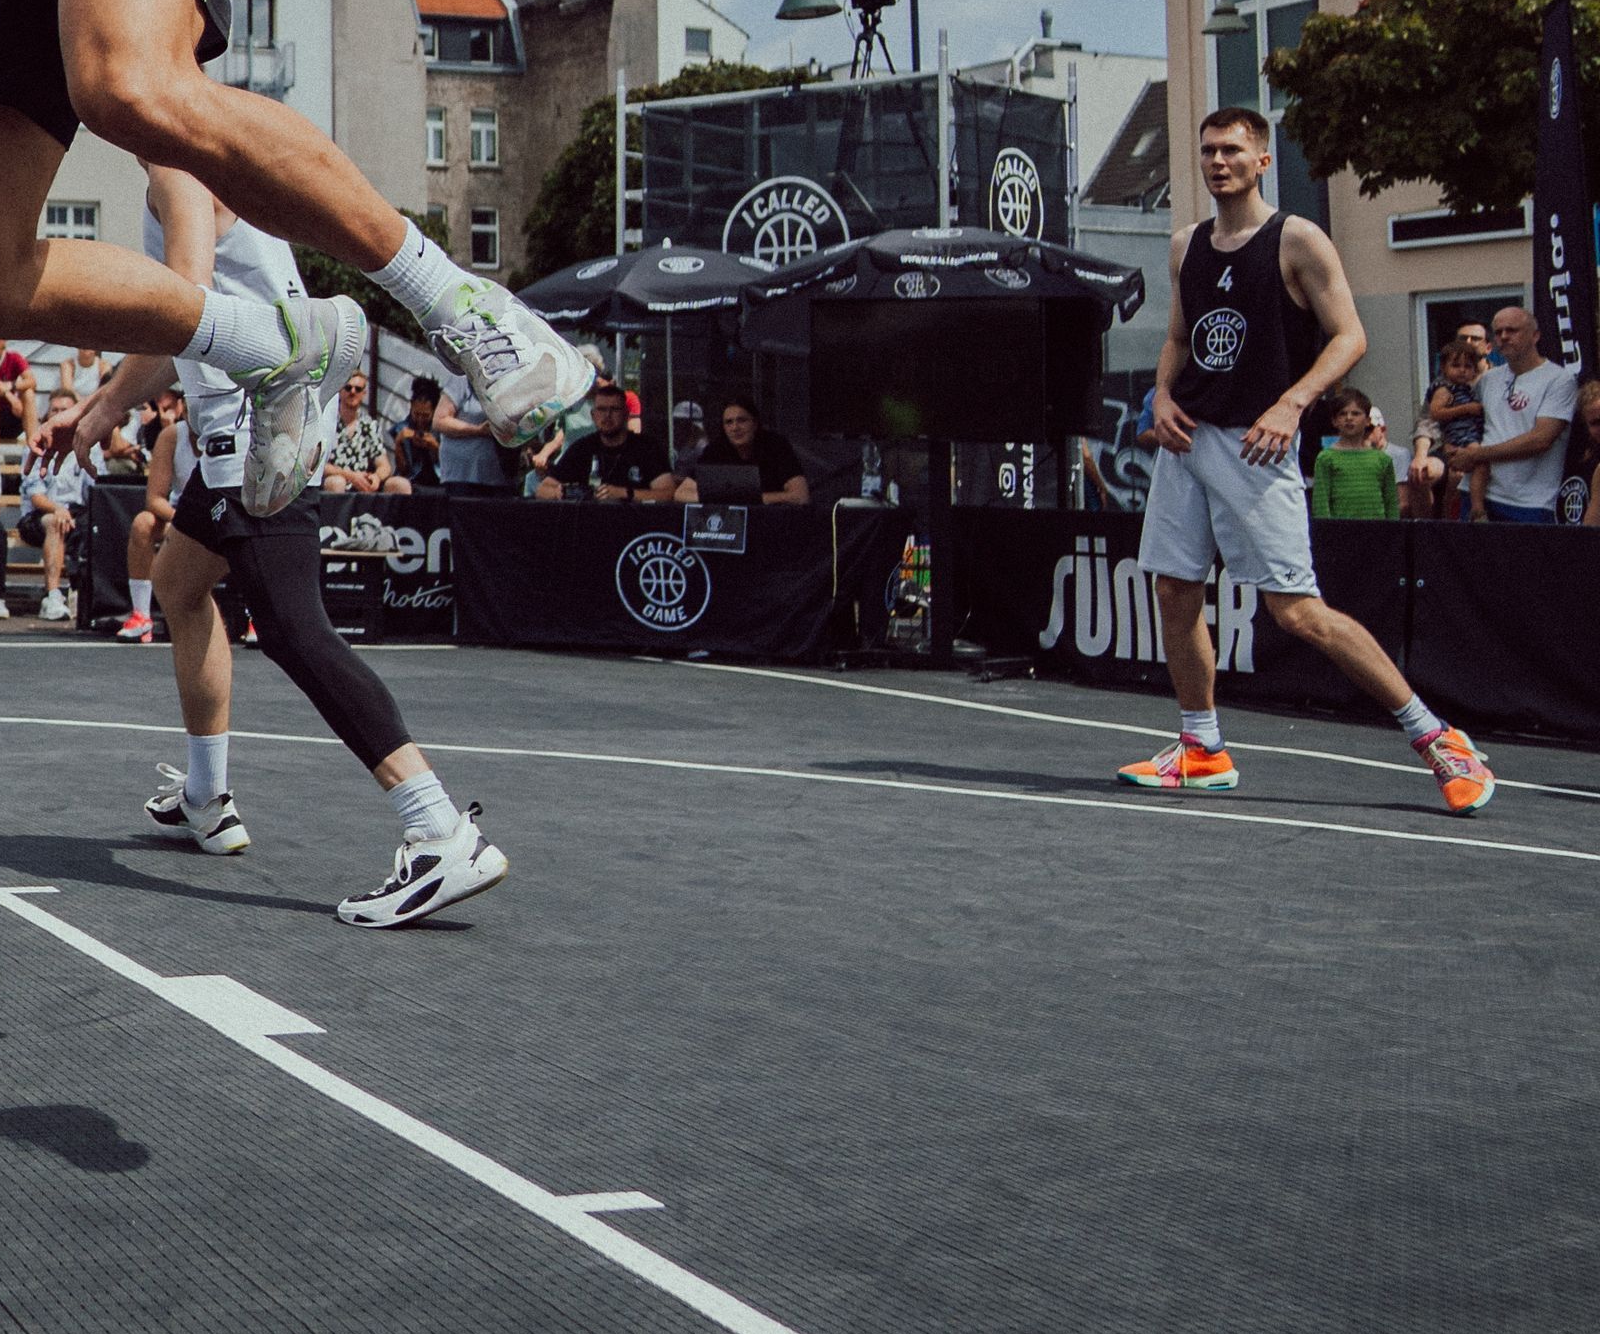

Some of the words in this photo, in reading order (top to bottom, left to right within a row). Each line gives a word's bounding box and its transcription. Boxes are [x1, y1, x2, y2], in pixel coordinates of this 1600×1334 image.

[998, 157, 1036, 192] CALLED
[741, 210, 755, 229] I
[753, 188, 831, 225] CALLED
[1217, 265, 1233, 292] 4
[1208, 312, 1244, 330] CALLED
[1204, 353, 1235, 367] GAME
[629, 551, 639, 566] I
[636, 540, 696, 568] CALLED
[642, 602, 688, 623] GAME
